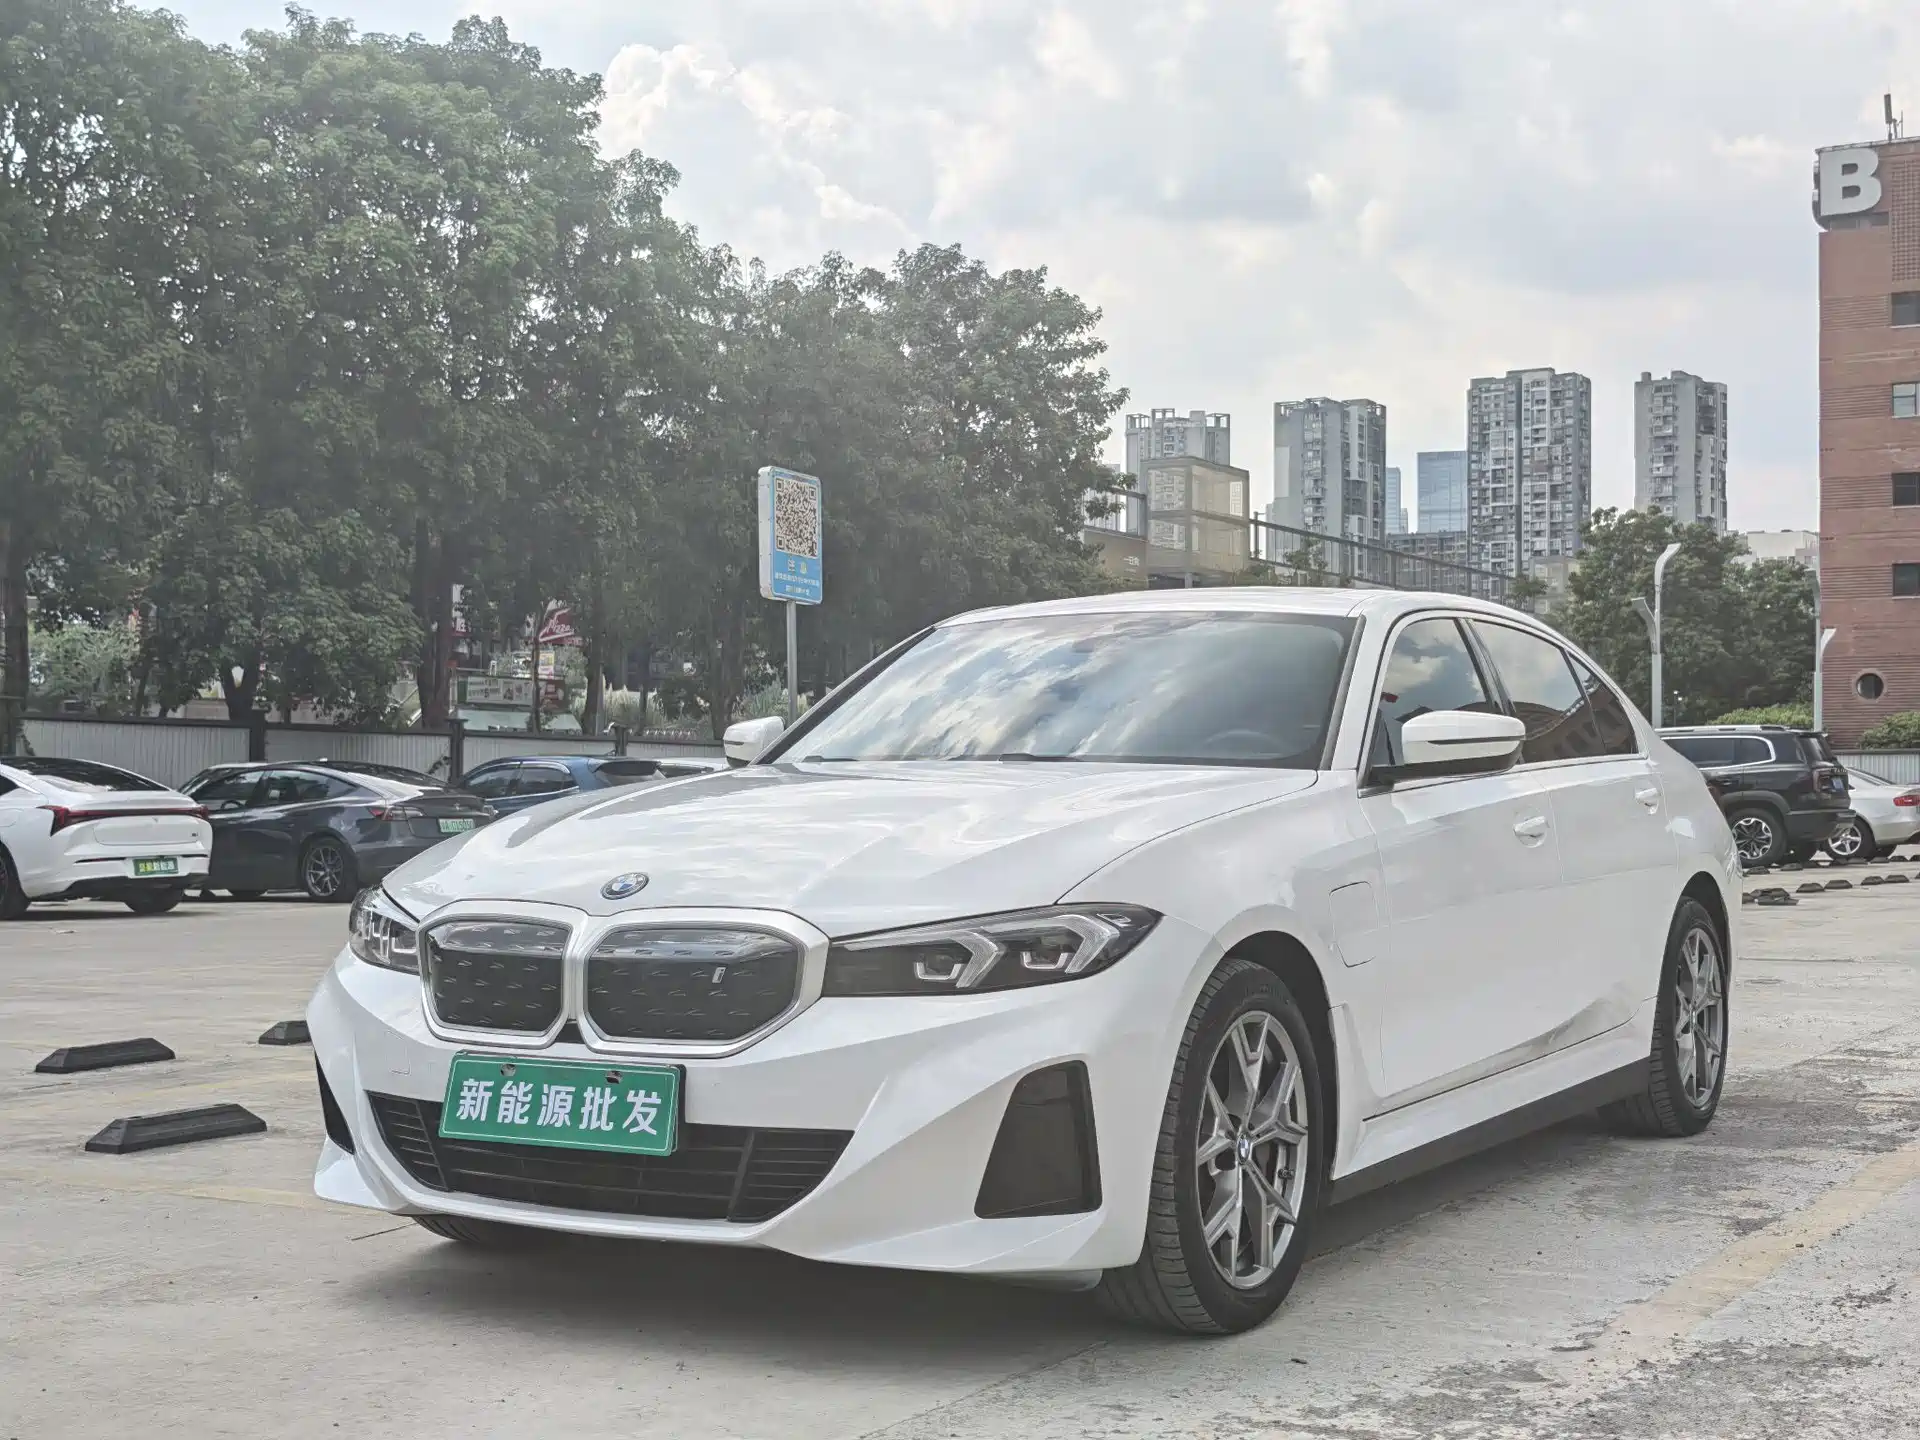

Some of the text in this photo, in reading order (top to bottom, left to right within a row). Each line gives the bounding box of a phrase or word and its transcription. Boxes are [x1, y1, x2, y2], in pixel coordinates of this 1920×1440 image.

[1819, 148, 1882, 217] B
[456, 1079, 662, 1135] 新能源批发
